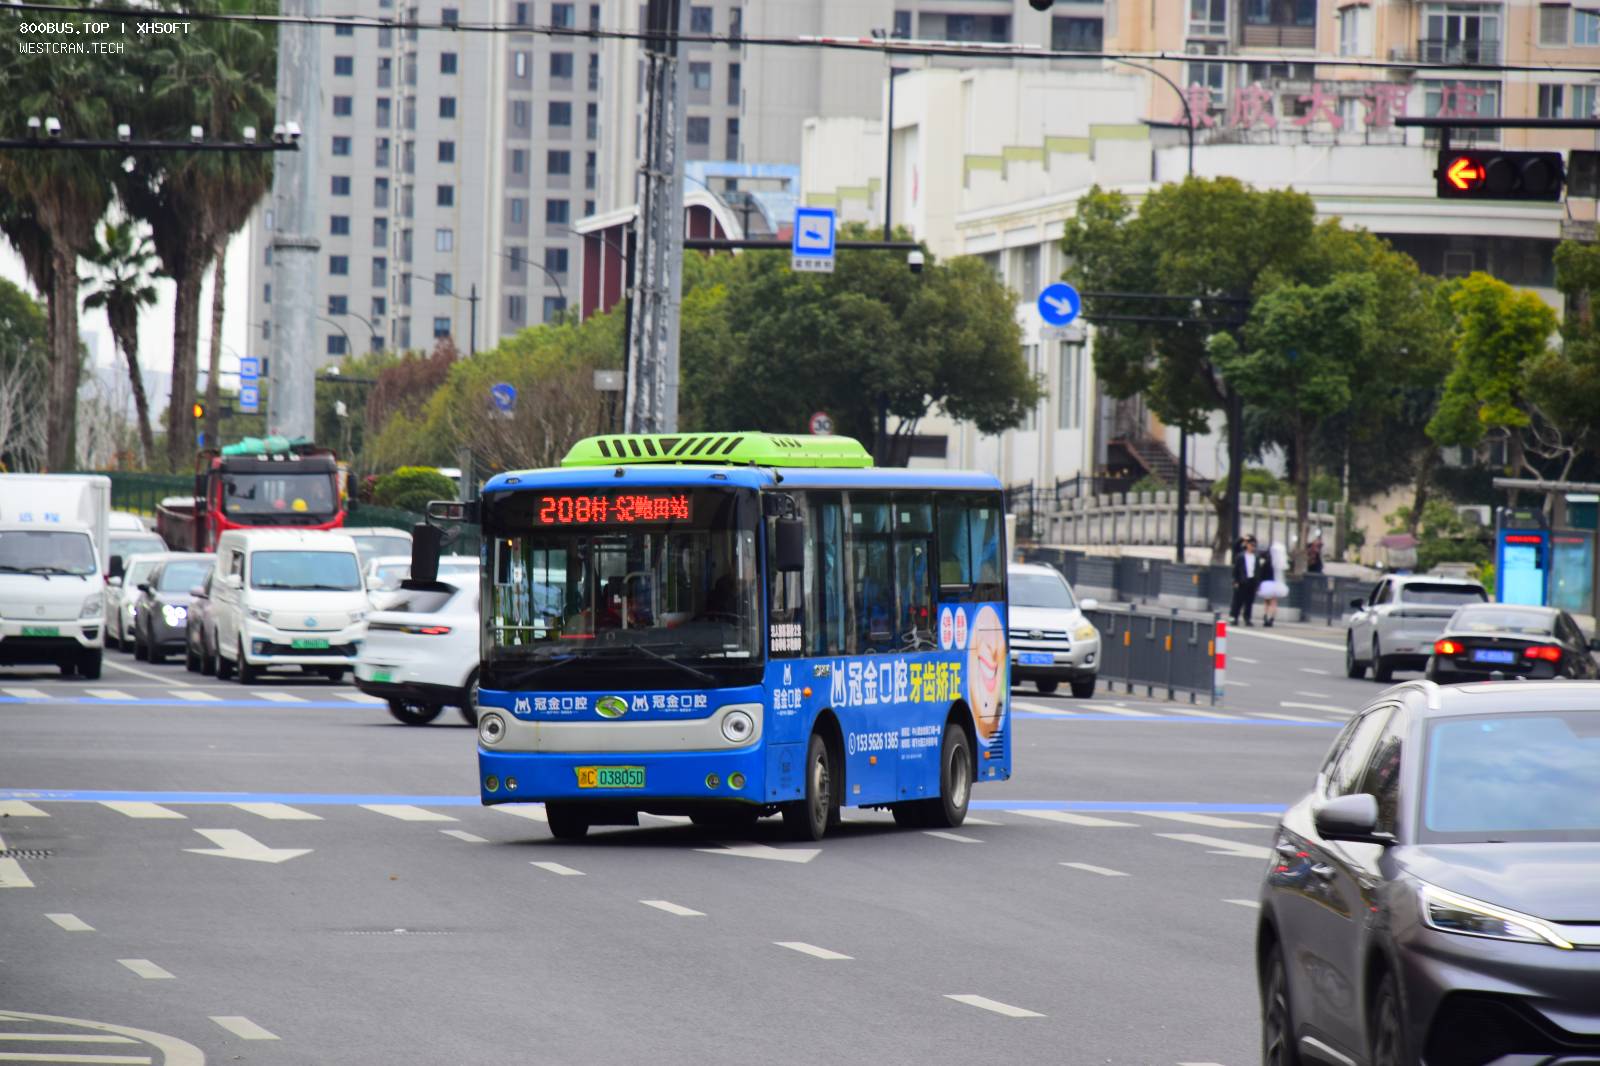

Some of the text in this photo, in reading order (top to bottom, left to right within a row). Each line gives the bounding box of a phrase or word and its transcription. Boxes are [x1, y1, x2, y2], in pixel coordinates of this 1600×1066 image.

[848, 658, 962, 707] 冠金口腔 牙齿矫正
[534, 697, 588, 711] 冠金口腔
[652, 694, 707, 709] 冠金口腔
[773, 687, 802, 710] 冠金口腔
